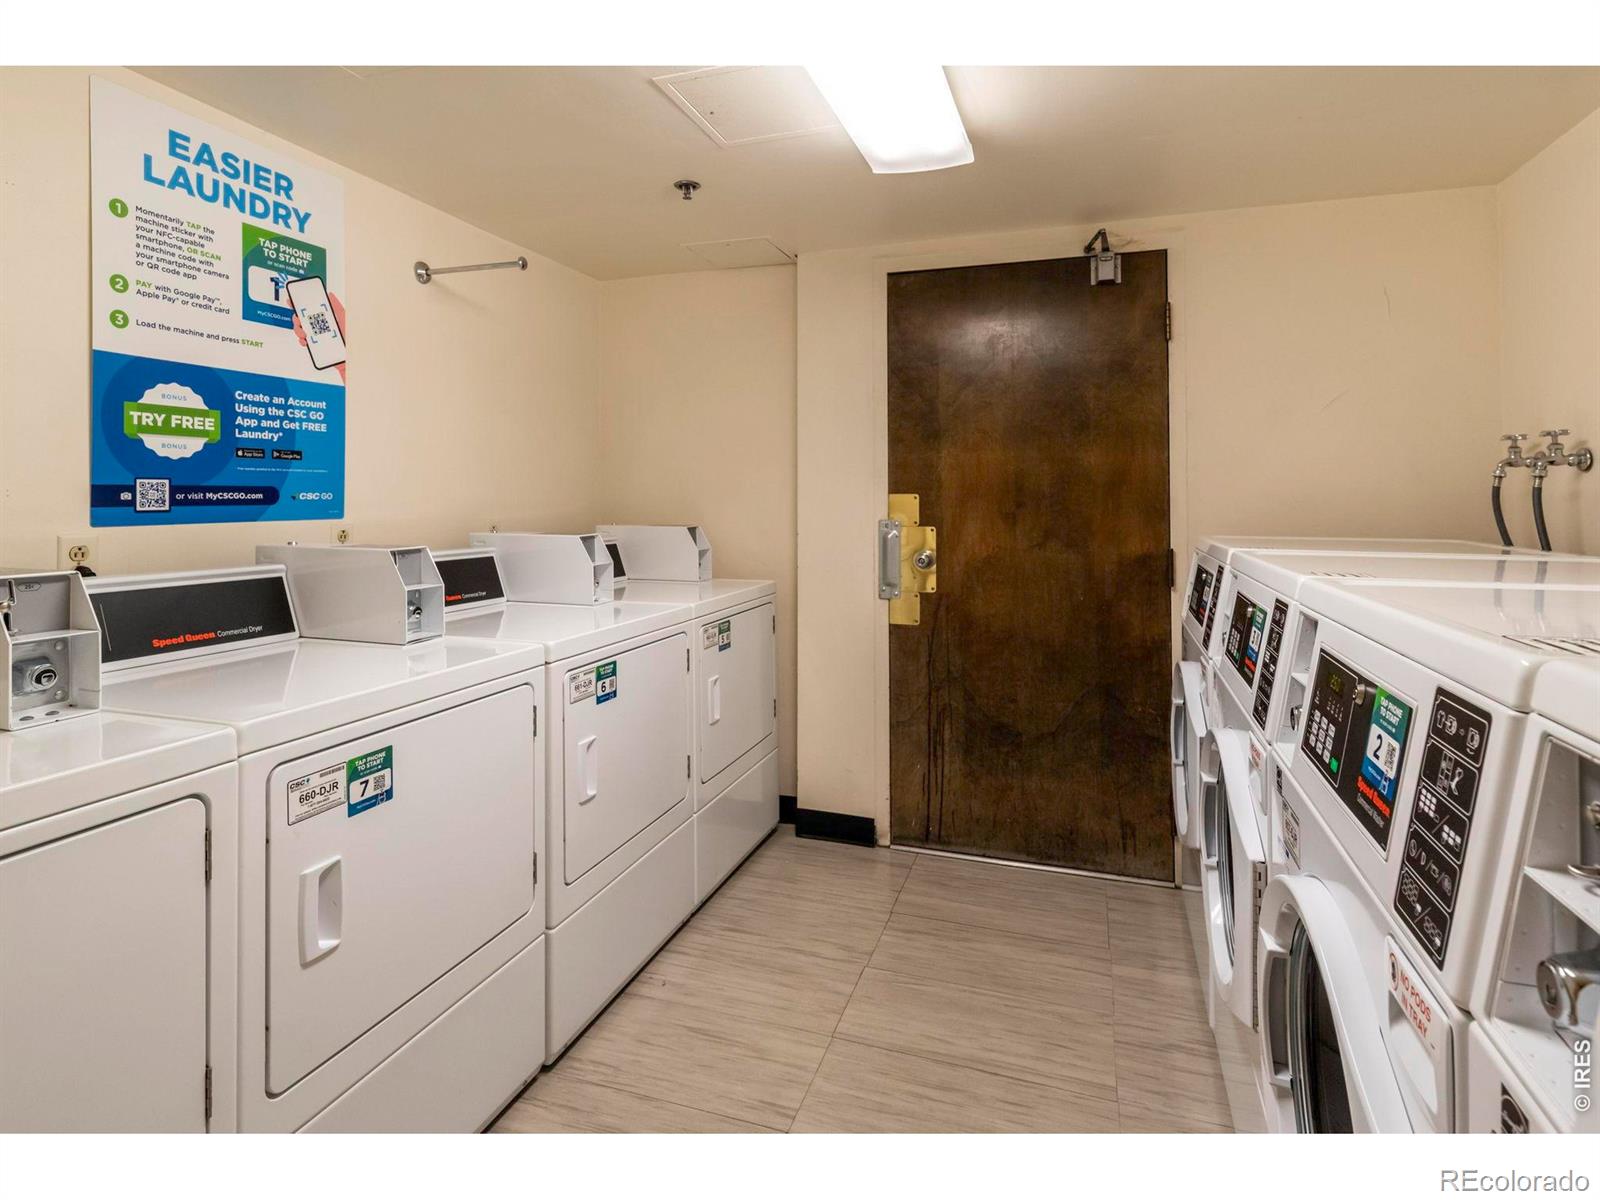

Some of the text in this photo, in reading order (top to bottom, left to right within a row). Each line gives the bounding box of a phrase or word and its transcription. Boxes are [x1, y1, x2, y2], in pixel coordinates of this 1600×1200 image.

[168, 129, 294, 201] EASIER
[144, 153, 312, 234] LAUNDRY
[115, 202, 122, 214] 1
[136, 205, 215, 235] Momentarily TAP the
[136, 215, 214, 243] machine sticker with
[136, 224, 205, 249] your NFC-capable
[136, 233, 222, 262] smartphone, OR SCAN
[142, 244, 176, 258] machine
[178, 254, 196, 263] code
[198, 259, 214, 268] with
[258, 238, 312, 262] TAP PHONE
[263, 248, 309, 268] TO START
[136, 251, 230, 280] your smartphone camera
[146, 262, 160, 271] QR
[162, 266, 181, 276] code
[182, 272, 198, 280] app
[114, 278, 124, 290] 2
[136, 280, 152, 288] PAY
[154, 284, 172, 294] with
[174, 288, 200, 301] Google
[136, 288, 160, 300] Apple
[191, 300, 212, 311] credit
[214, 306, 230, 315] card
[115, 313, 124, 325] 3
[136, 319, 264, 348] Load the machine and press START
[161, 393, 188, 402] BONUS
[235, 390, 270, 404] Create
[288, 397, 326, 410] Account
[129, 410, 215, 431] TRY FREE
[235, 403, 324, 420] Using the CSC GO
[235, 416, 327, 432] App and Get FREE
[188, 491, 204, 500] visit
[206, 491, 263, 502] MyCSCGO.com
[152, 625, 263, 648] Speed Queen Commercial Dryer
[601, 682, 606, 692] 6
[1380, 696, 1403, 720] TAP PHONE
[1380, 706, 1386, 717] TO
[1386, 710, 1400, 726] START
[355, 750, 386, 766] TAP PHONE
[1373, 734, 1383, 761] 2
[366, 758, 384, 770] START
[290, 780, 305, 790] CSC
[298, 781, 339, 804] 660-DJR
[360, 779, 369, 797] 7
[1400, 970, 1431, 1022] NO PODS
[1409, 1003, 1427, 1038] TRAY
